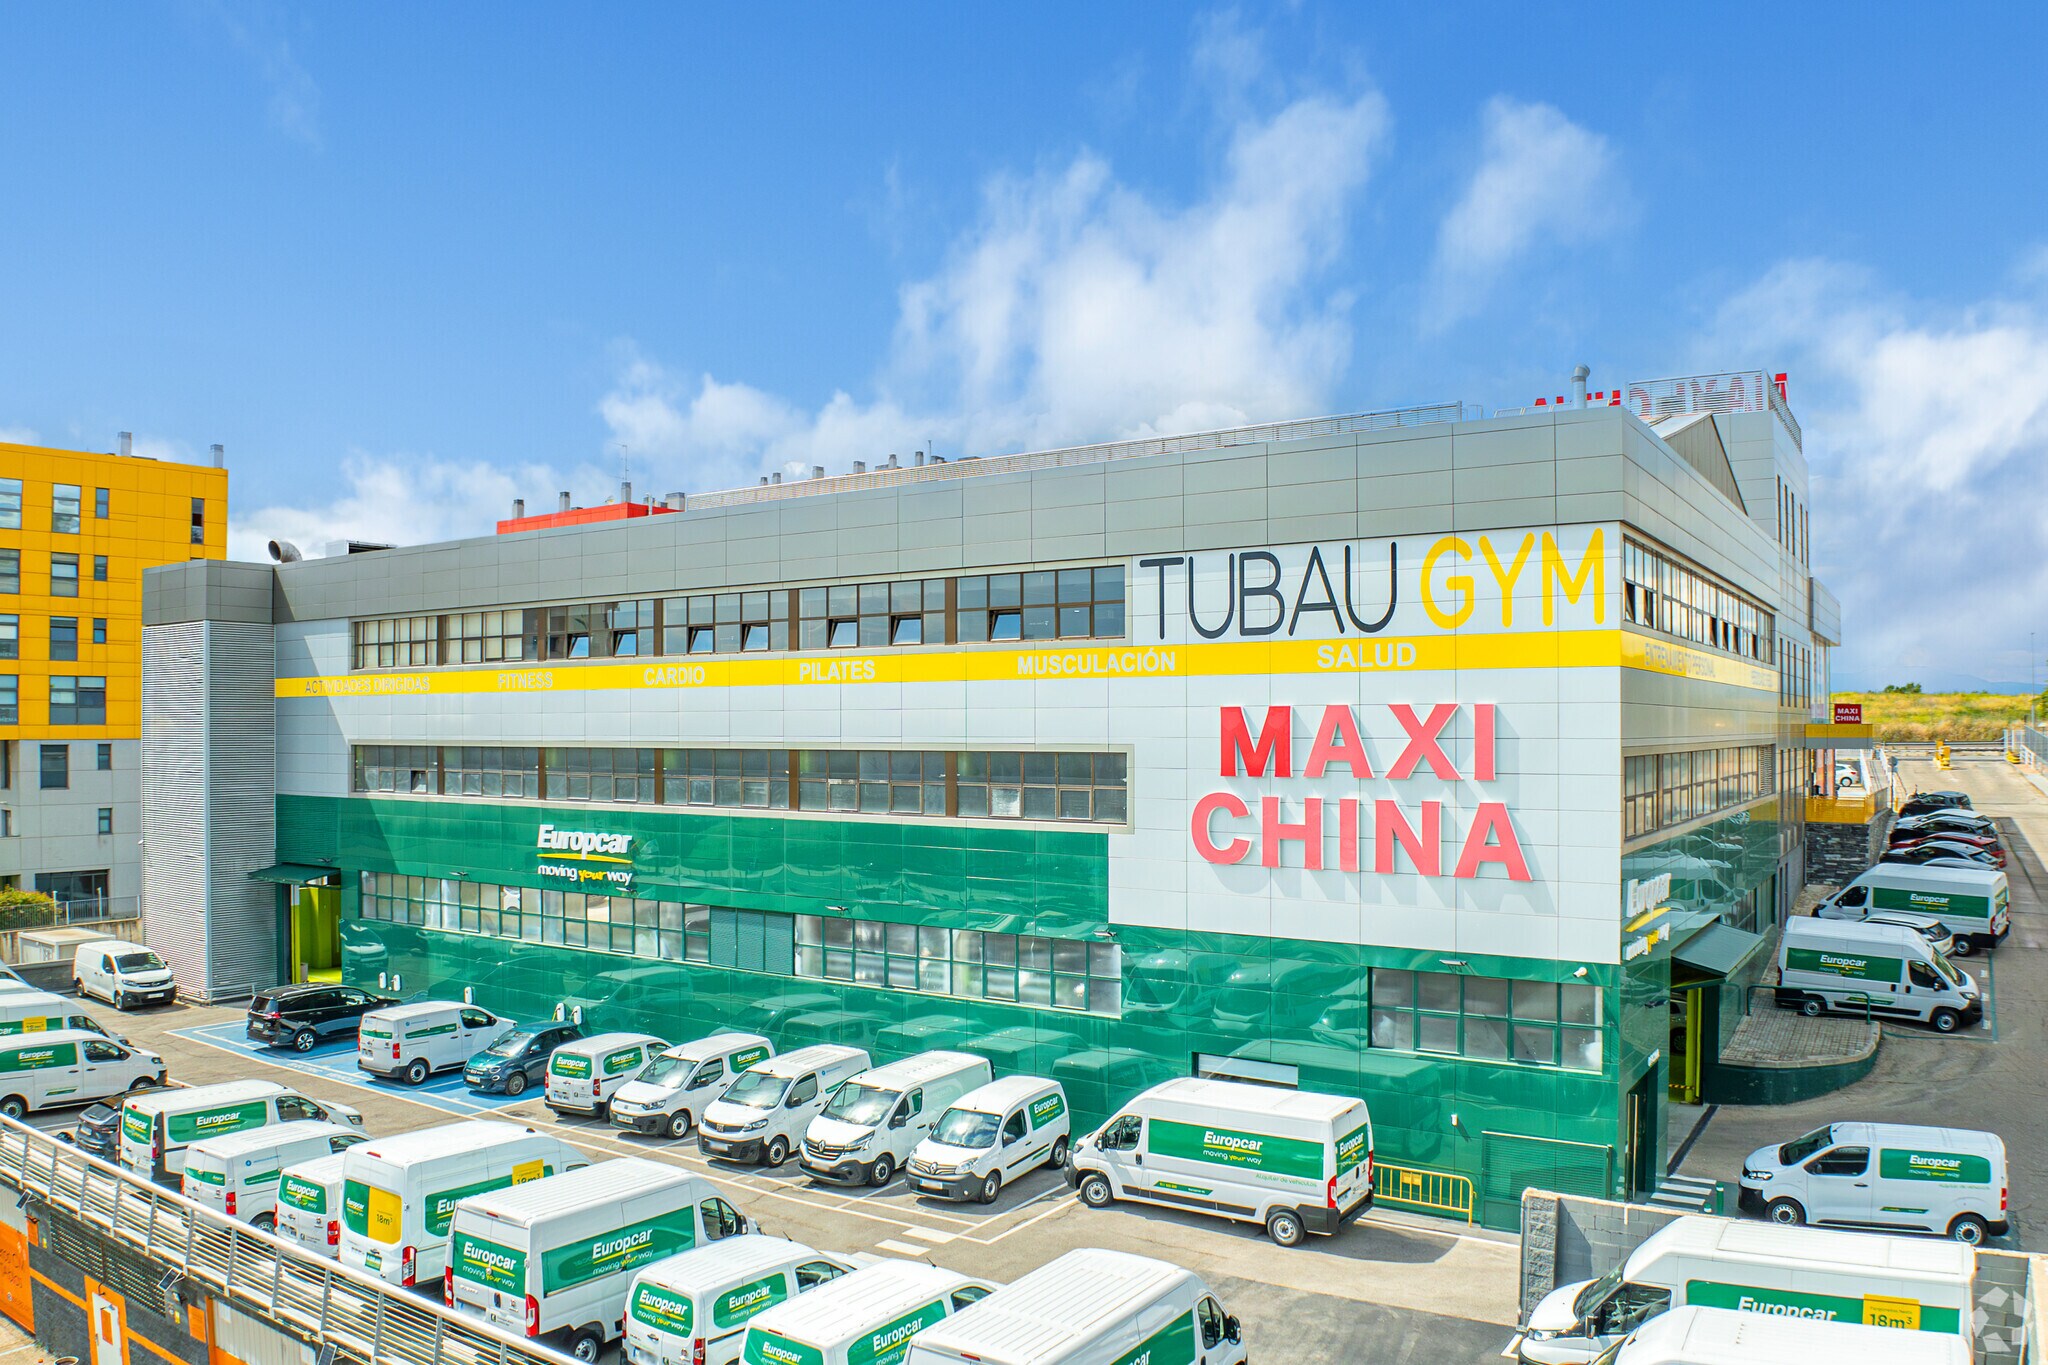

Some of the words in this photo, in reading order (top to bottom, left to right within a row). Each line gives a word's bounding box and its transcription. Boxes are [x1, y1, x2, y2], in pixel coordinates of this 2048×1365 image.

[1139, 541, 1398, 640] TUBAU
[1420, 528, 1606, 630] GYM
[1017, 648, 1176, 675] MUSCULACIÓN
[1316, 643, 1417, 669] SALUD
[498, 672, 553, 688] FITNESS
[643, 666, 706, 685] CARDIO
[799, 660, 876, 682] PILATES
[305, 677, 371, 694] ACTIVIDADES
[374, 676, 430, 693] DIRIGIDAS
[1220, 703, 1497, 782] MAXI
[537, 824, 633, 860] Europcar
[1191, 792, 1533, 882] CHINA
[538, 864, 577, 882] moving
[578, 869, 606, 883] your
[606, 871, 632, 886] way
[1910, 893, 1950, 904] Europcar
[1820, 954, 1867, 967] Europcar
[19, 1050, 54, 1060] Europcar
[557, 1056, 588, 1068] Europcar
[196, 1111, 241, 1126] Europcar
[1203, 1131, 1263, 1151] Europcar
[1203, 1149, 1228, 1160] moving
[1229, 1154, 1246, 1162] your
[1247, 1156, 1262, 1165] way
[1909, 1154, 1961, 1168] Europcar
[286, 1180, 319, 1198] Europcar
[592, 1228, 653, 1259] Europcar
[463, 1241, 516, 1270] Europcar
[592, 1261, 620, 1275] moving
[638, 1249, 654, 1259] way
[462, 1265, 486, 1280] moving
[639, 1289, 688, 1315] Europcar
[728, 1285, 771, 1309] Europcar
[637, 1310, 657, 1323] moving
[656, 1317, 671, 1326] your
[671, 1319, 685, 1331] way
[873, 1318, 923, 1352] Europcar
[762, 1341, 803, 1364] Europcar
